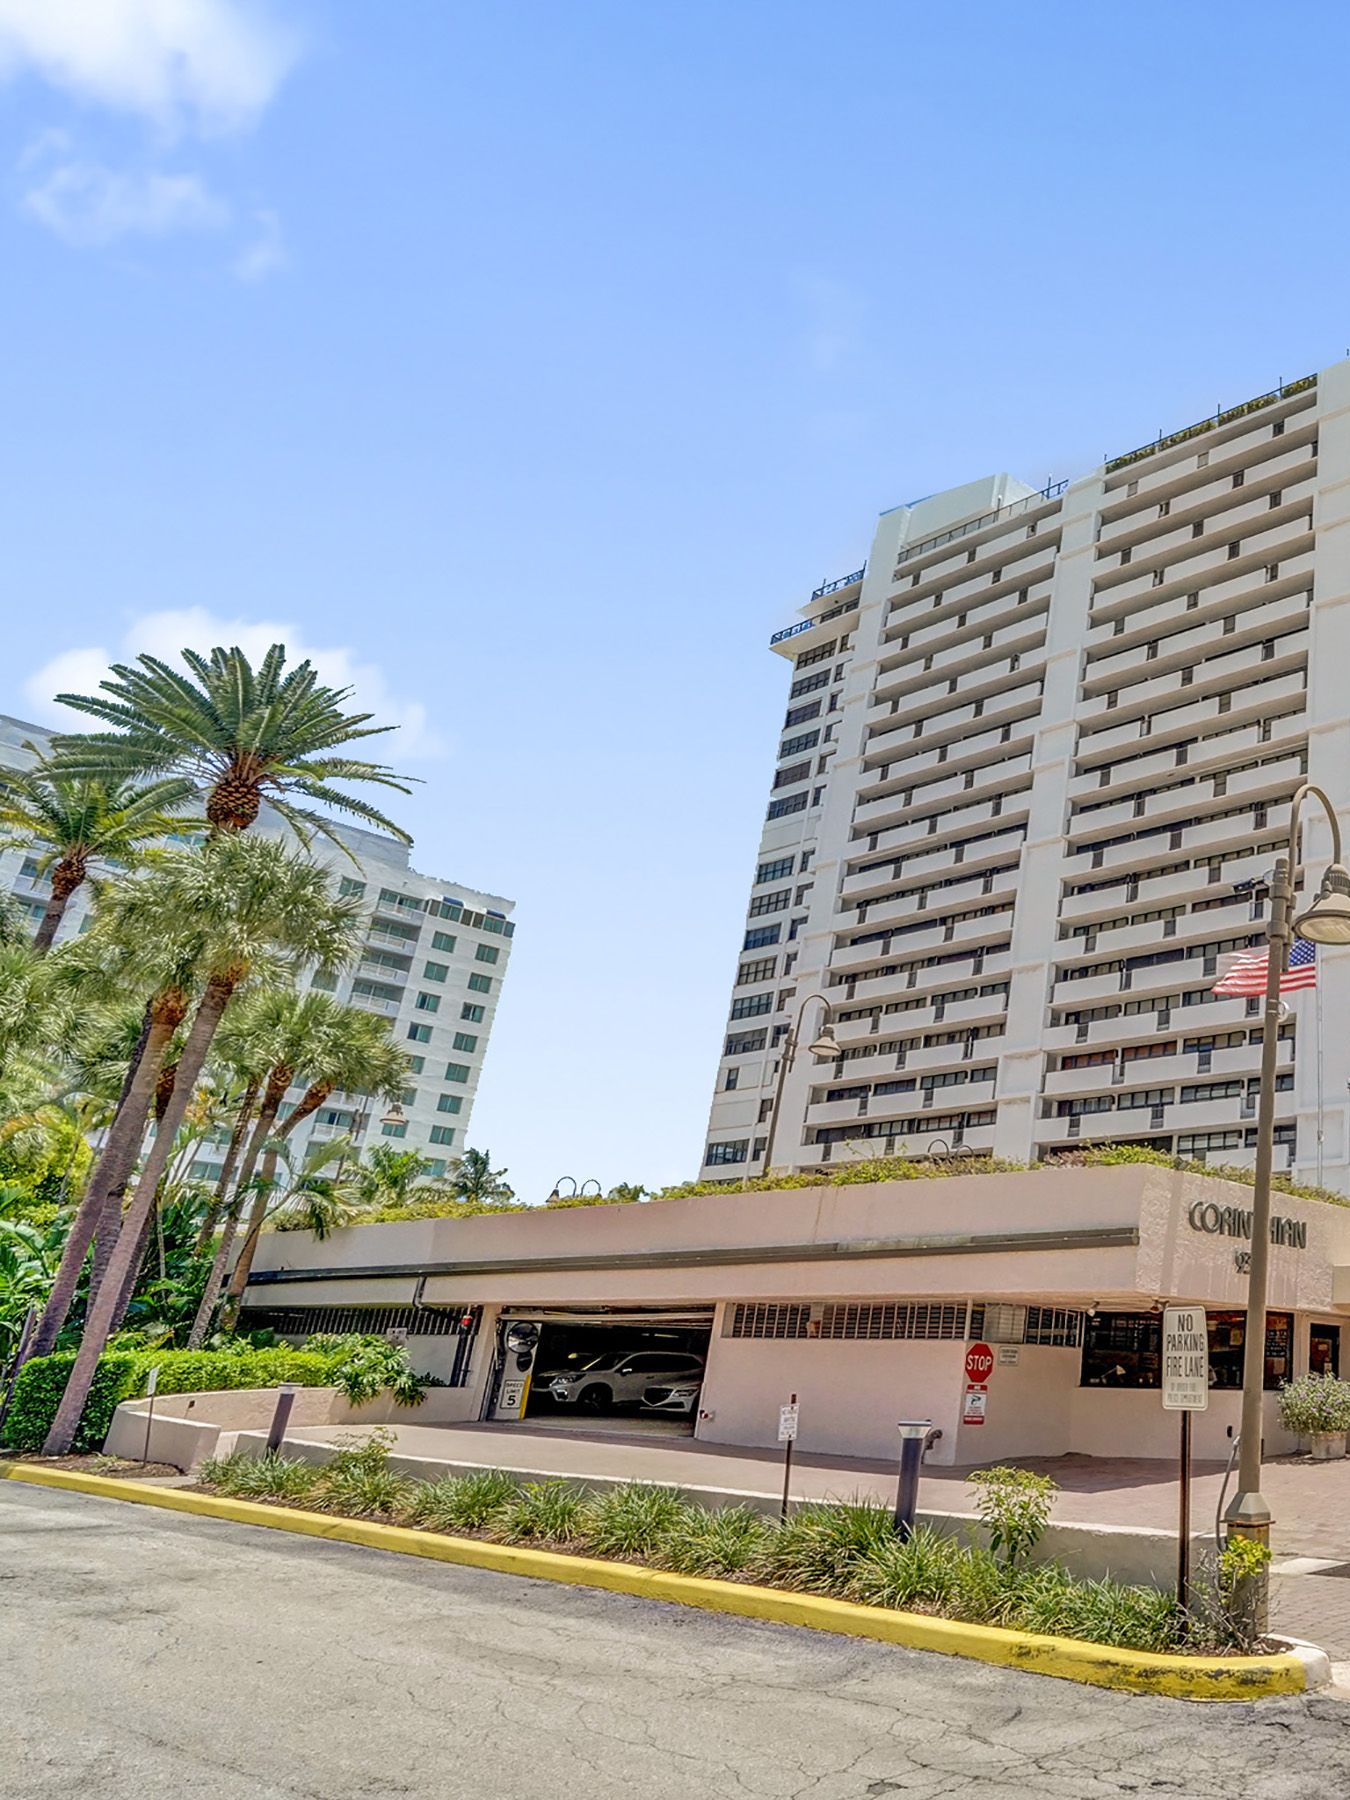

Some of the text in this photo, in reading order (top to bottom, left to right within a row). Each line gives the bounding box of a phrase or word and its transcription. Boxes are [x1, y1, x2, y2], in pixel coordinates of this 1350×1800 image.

[1188, 1201, 1307, 1249] CORINHIAN
[1177, 1314, 1194, 1332] NO
[1166, 1334, 1205, 1352] PARKING
[966, 1355, 992, 1371] STOP
[1166, 1356, 1204, 1378] FIRE LANE
[507, 1395, 516, 1405] 5
